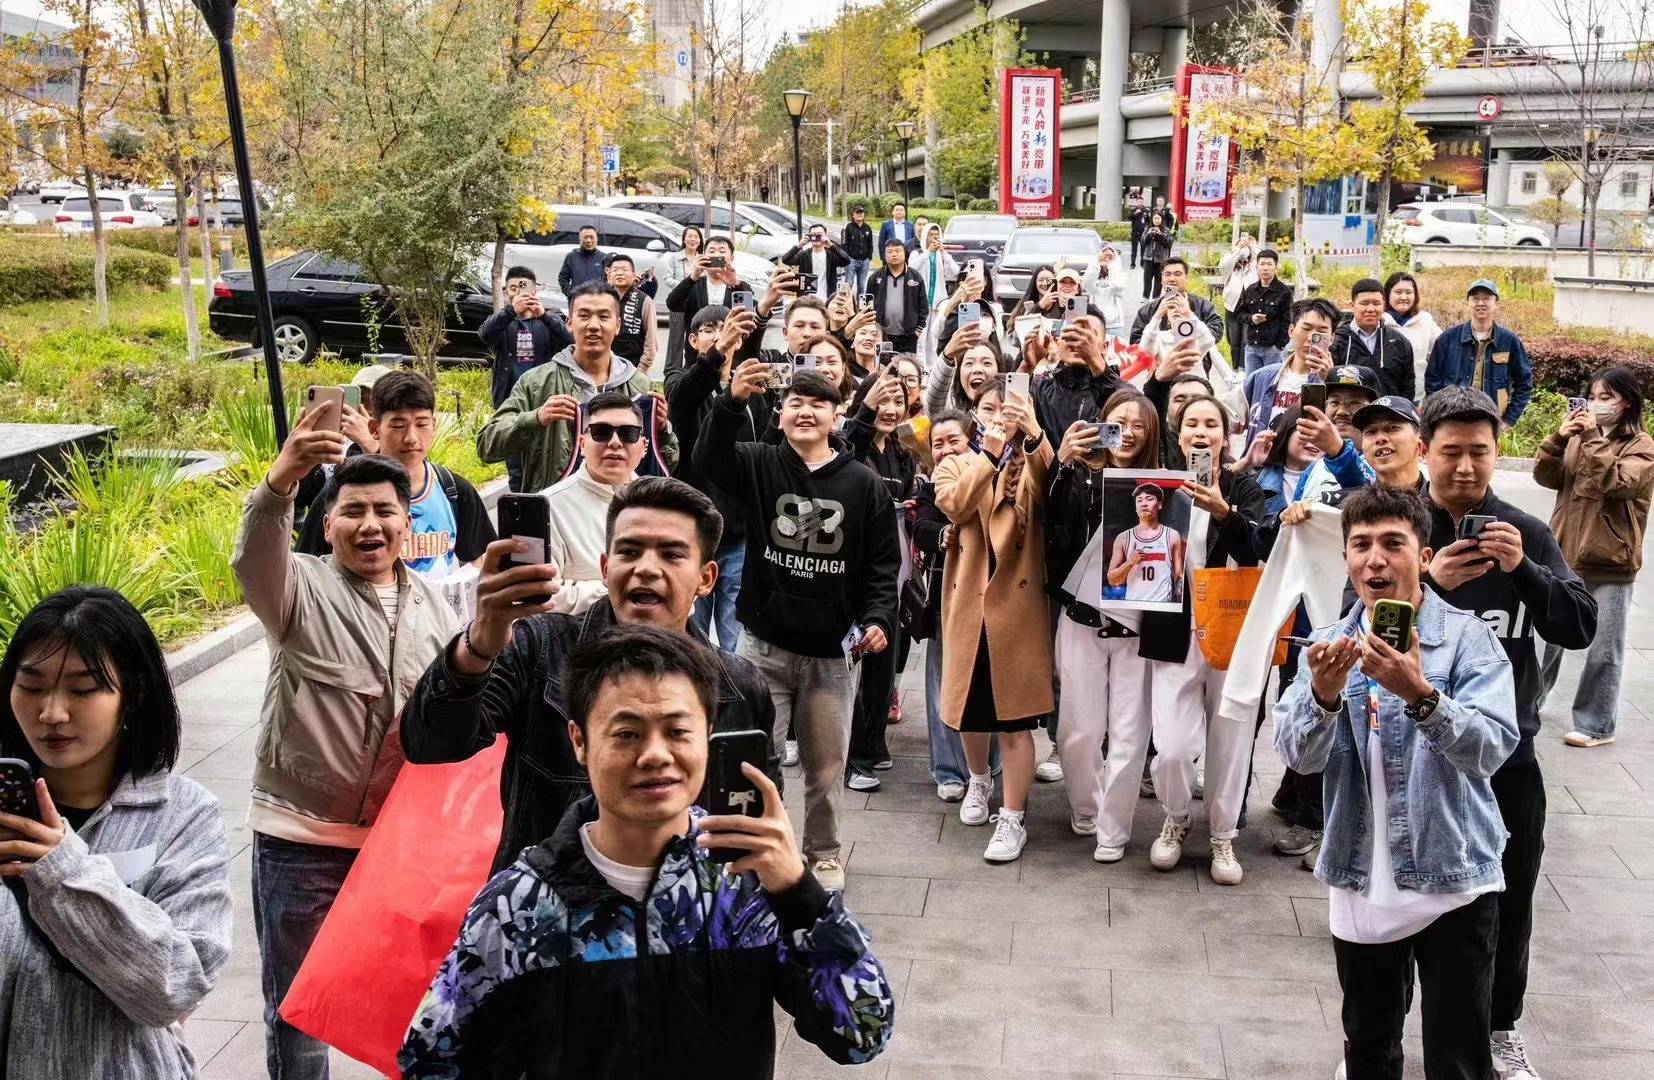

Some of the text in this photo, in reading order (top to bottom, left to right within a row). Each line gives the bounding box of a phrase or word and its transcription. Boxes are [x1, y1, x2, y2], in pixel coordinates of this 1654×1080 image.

[1033, 86, 1047, 170] 新疆人的新宽带
[1021, 131, 1030, 169] 万家美好
[764, 545, 846, 574] BALENCIAGA
[790, 569, 814, 579] PARIS
[1142, 566, 1155, 581] 10
